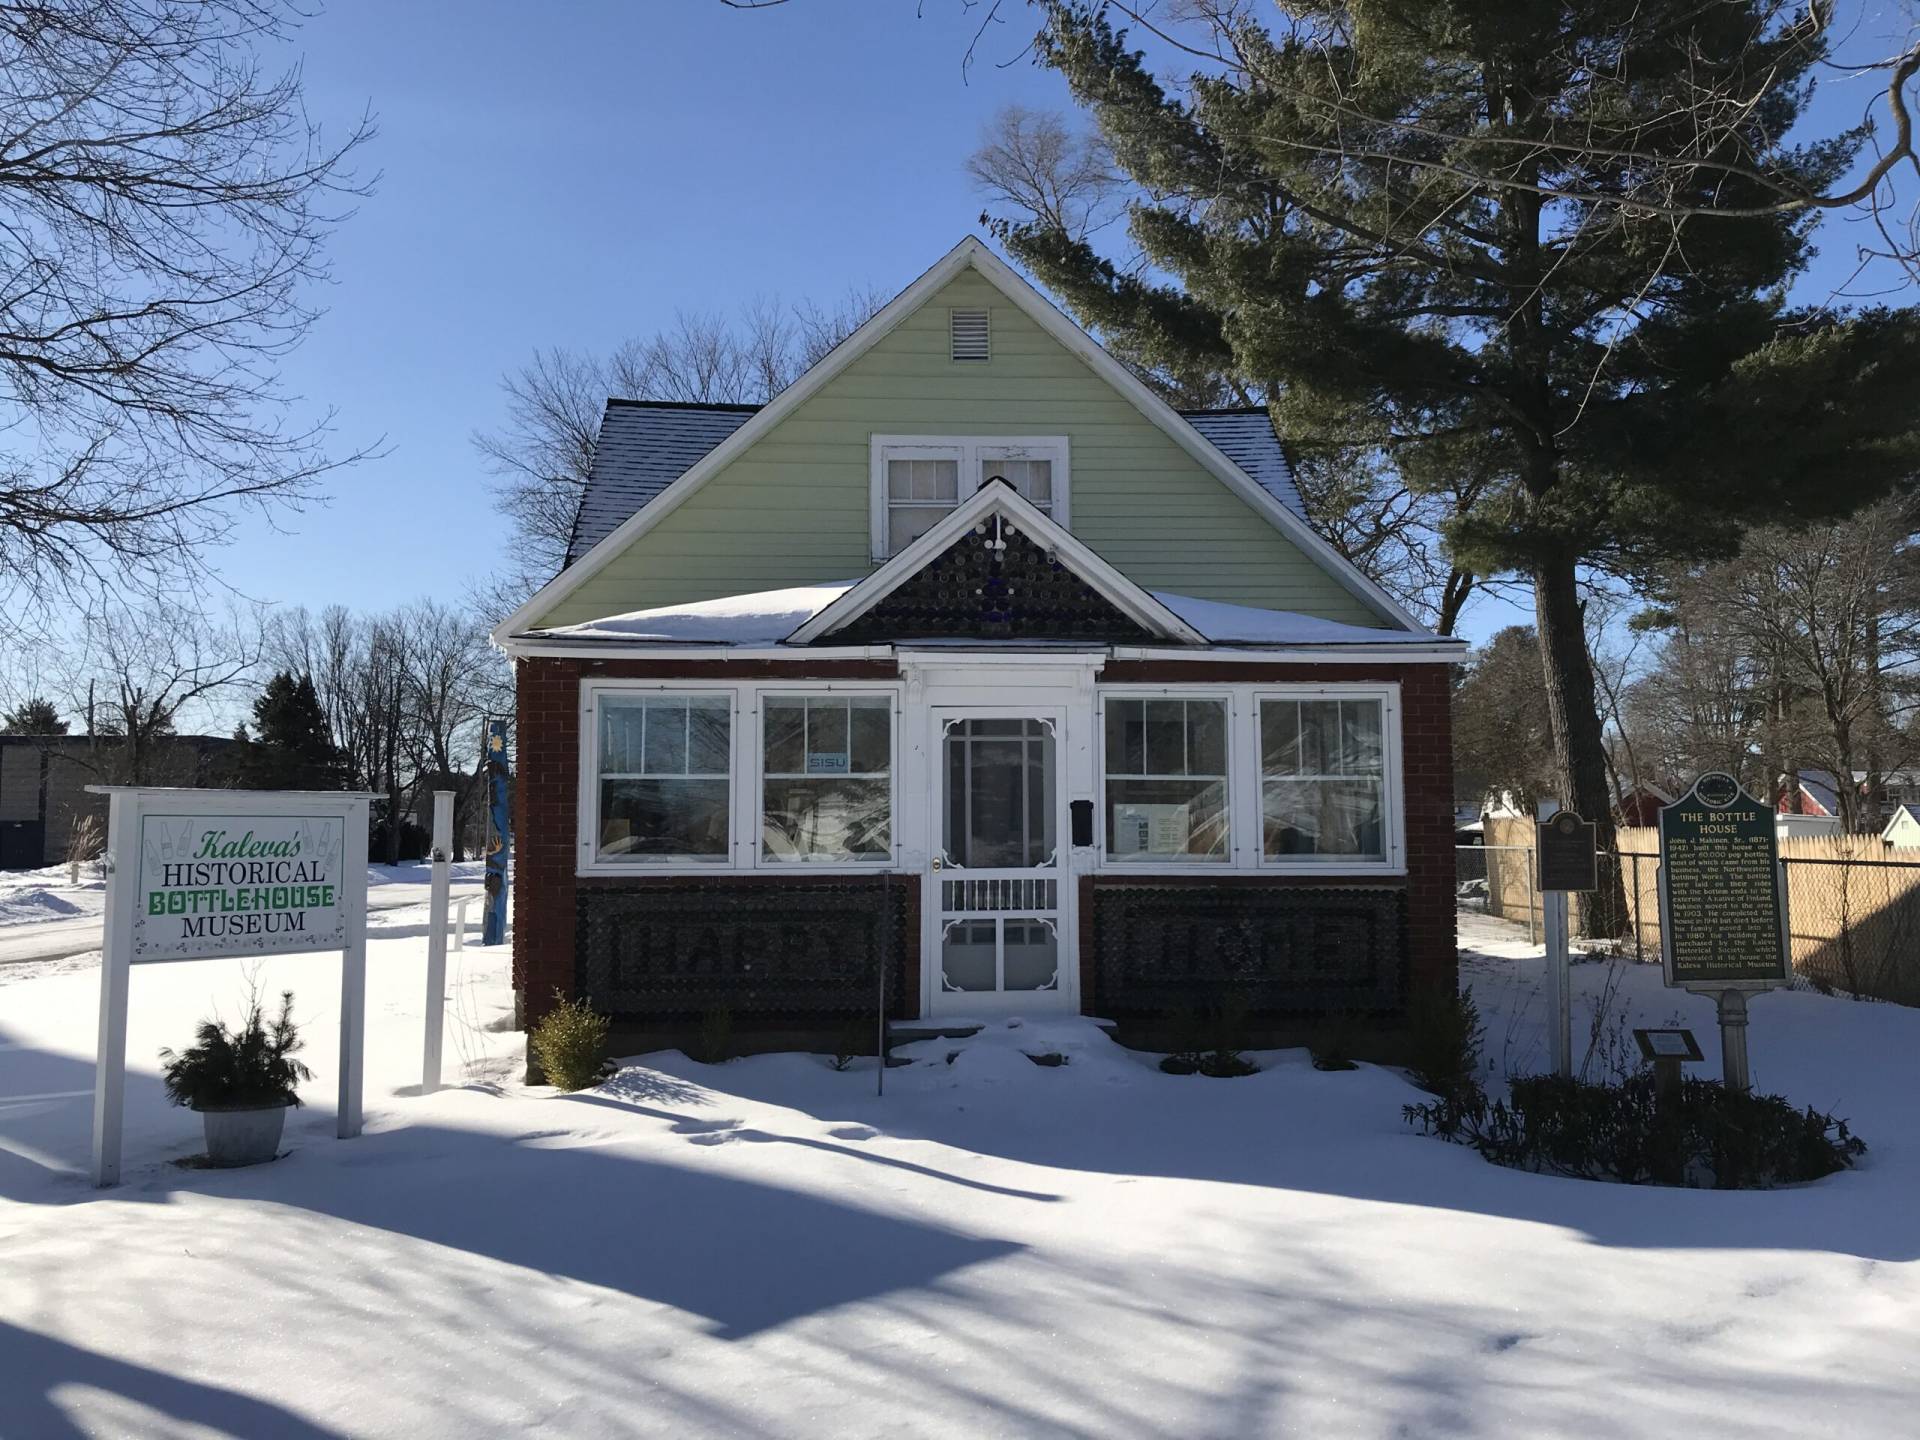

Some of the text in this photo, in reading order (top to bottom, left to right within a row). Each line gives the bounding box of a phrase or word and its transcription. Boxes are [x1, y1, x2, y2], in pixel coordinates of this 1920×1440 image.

[809, 758, 846, 768] SISU
[1680, 812, 1756, 822] THE BOTTLE
[1700, 824, 1738, 834] HOUSE
[193, 830, 302, 860] Kaleva's
[162, 860, 326, 887] HISTORICAL
[148, 885, 336, 916] BOTTLEHOUSE
[181, 912, 306, 938] MUSEUM
